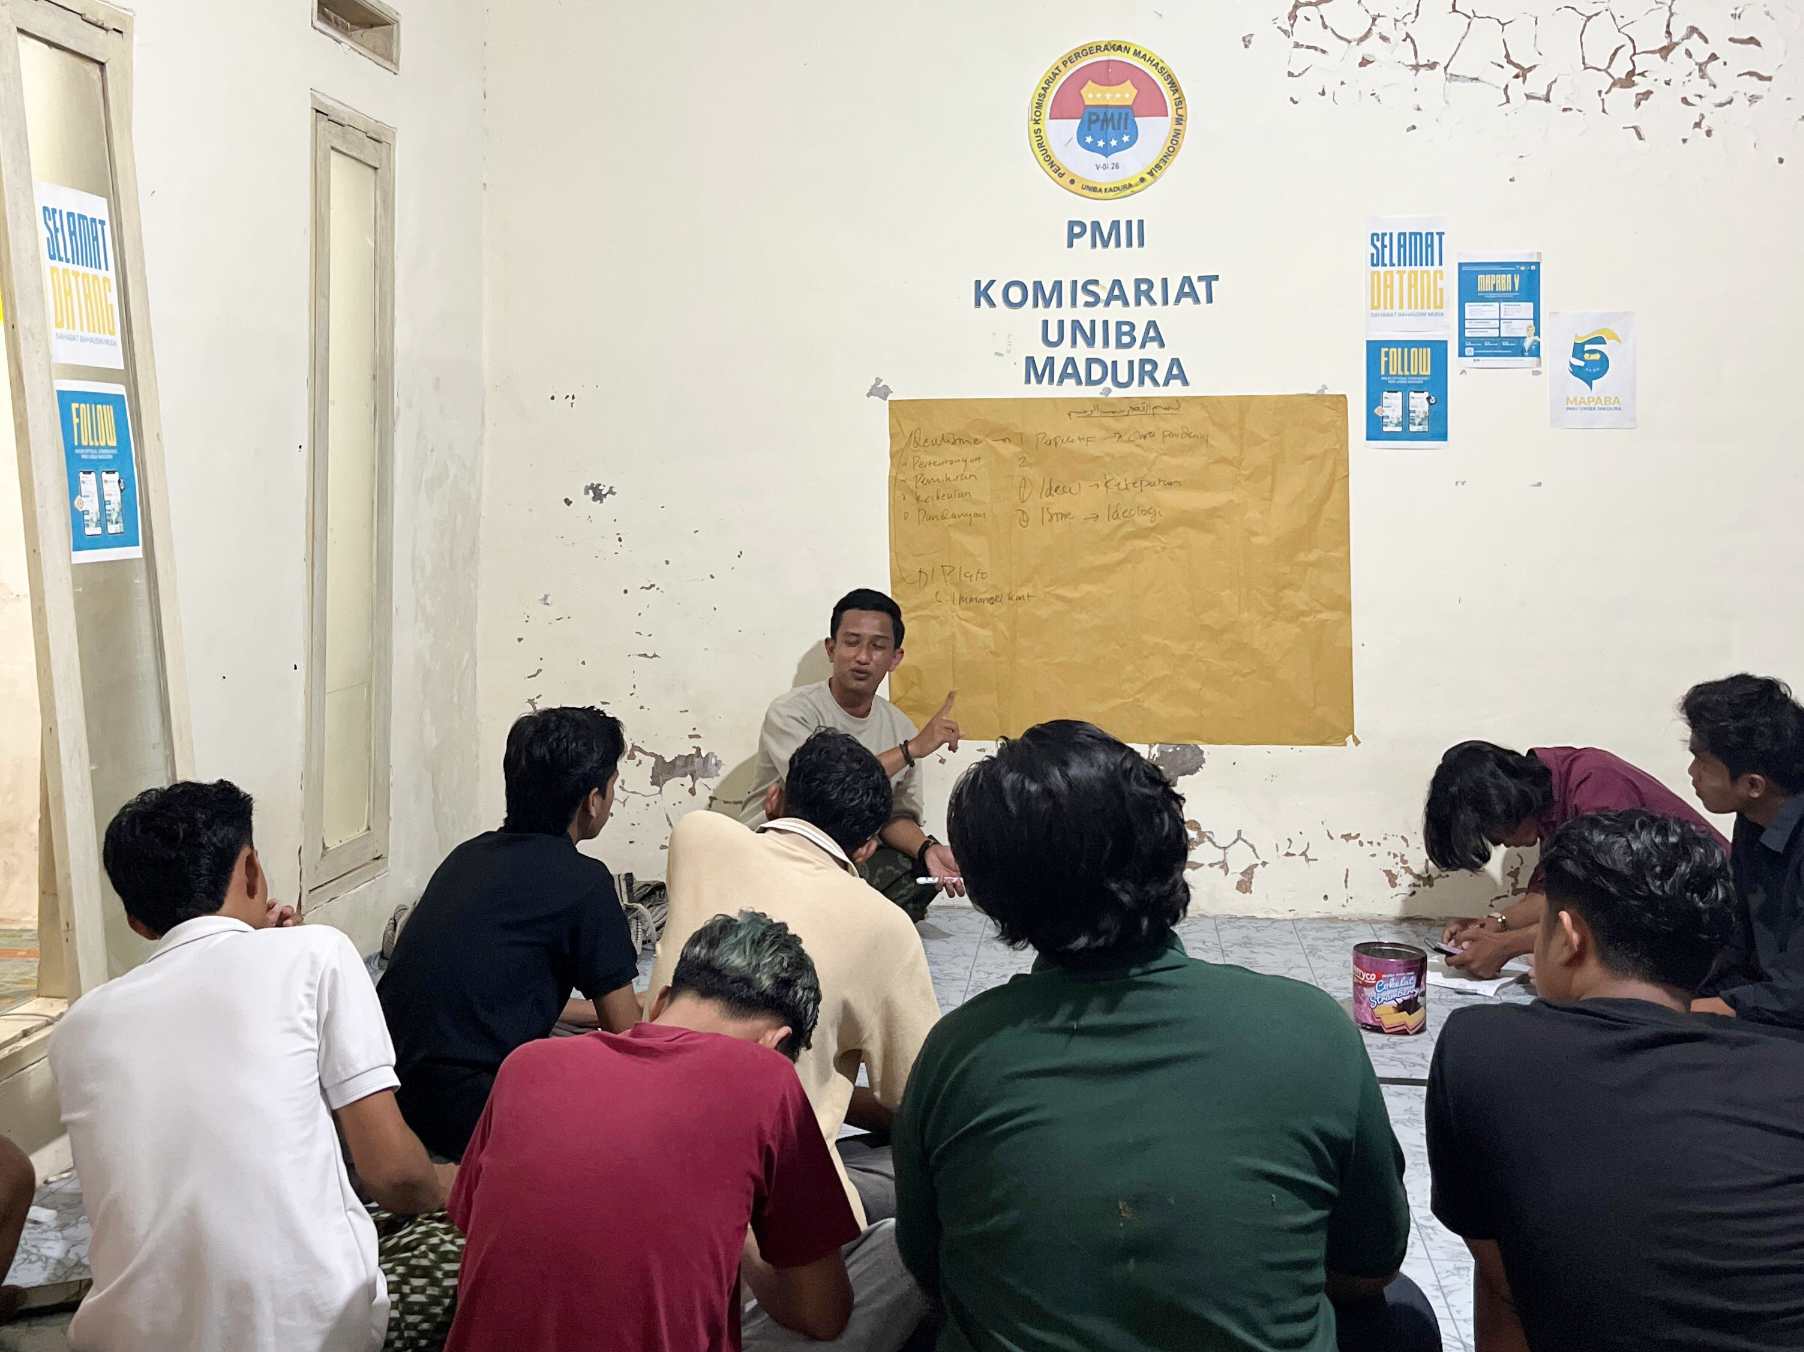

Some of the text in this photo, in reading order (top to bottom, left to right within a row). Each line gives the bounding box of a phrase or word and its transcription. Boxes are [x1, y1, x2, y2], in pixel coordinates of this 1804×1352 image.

[1132, 47, 1178, 96] MAHASISWA
[1033, 66, 1062, 125] KOMISARIAT
[1087, 111, 1130, 131] PMII
[1034, 127, 1066, 179] PENGURUS
[1148, 127, 1184, 178] INDONESIA
[42, 205, 109, 272] SELAMAT
[1066, 219, 1145, 249] PMII
[1370, 231, 1445, 267] SELAMAT
[49, 265, 117, 336] DATANG
[974, 275, 1220, 310] KOMISARIAT
[1370, 270, 1445, 310] DATANG
[1041, 319, 1166, 350] UNIBA
[1024, 356, 1191, 389] MADURA
[1380, 347, 1431, 376] FOLLOW
[1566, 395, 1621, 406] MAPABA
[71, 402, 117, 447] FOLLOW
